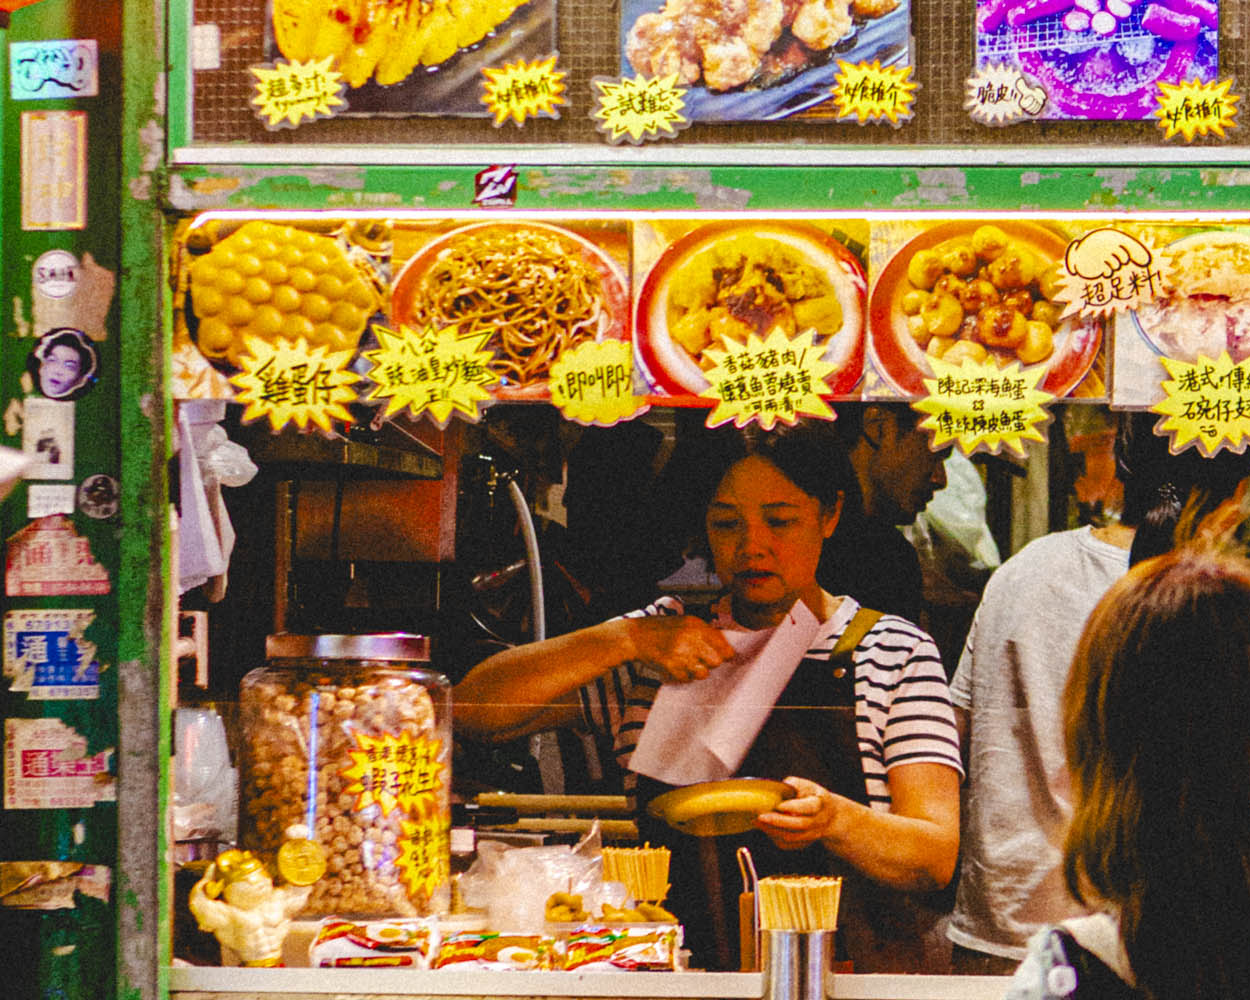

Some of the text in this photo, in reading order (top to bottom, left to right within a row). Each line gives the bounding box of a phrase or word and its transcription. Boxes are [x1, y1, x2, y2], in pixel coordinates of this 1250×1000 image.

[256, 356, 338, 407] 雞蛋仔
[938, 374, 1028, 400] 陳記深海魚蛋
